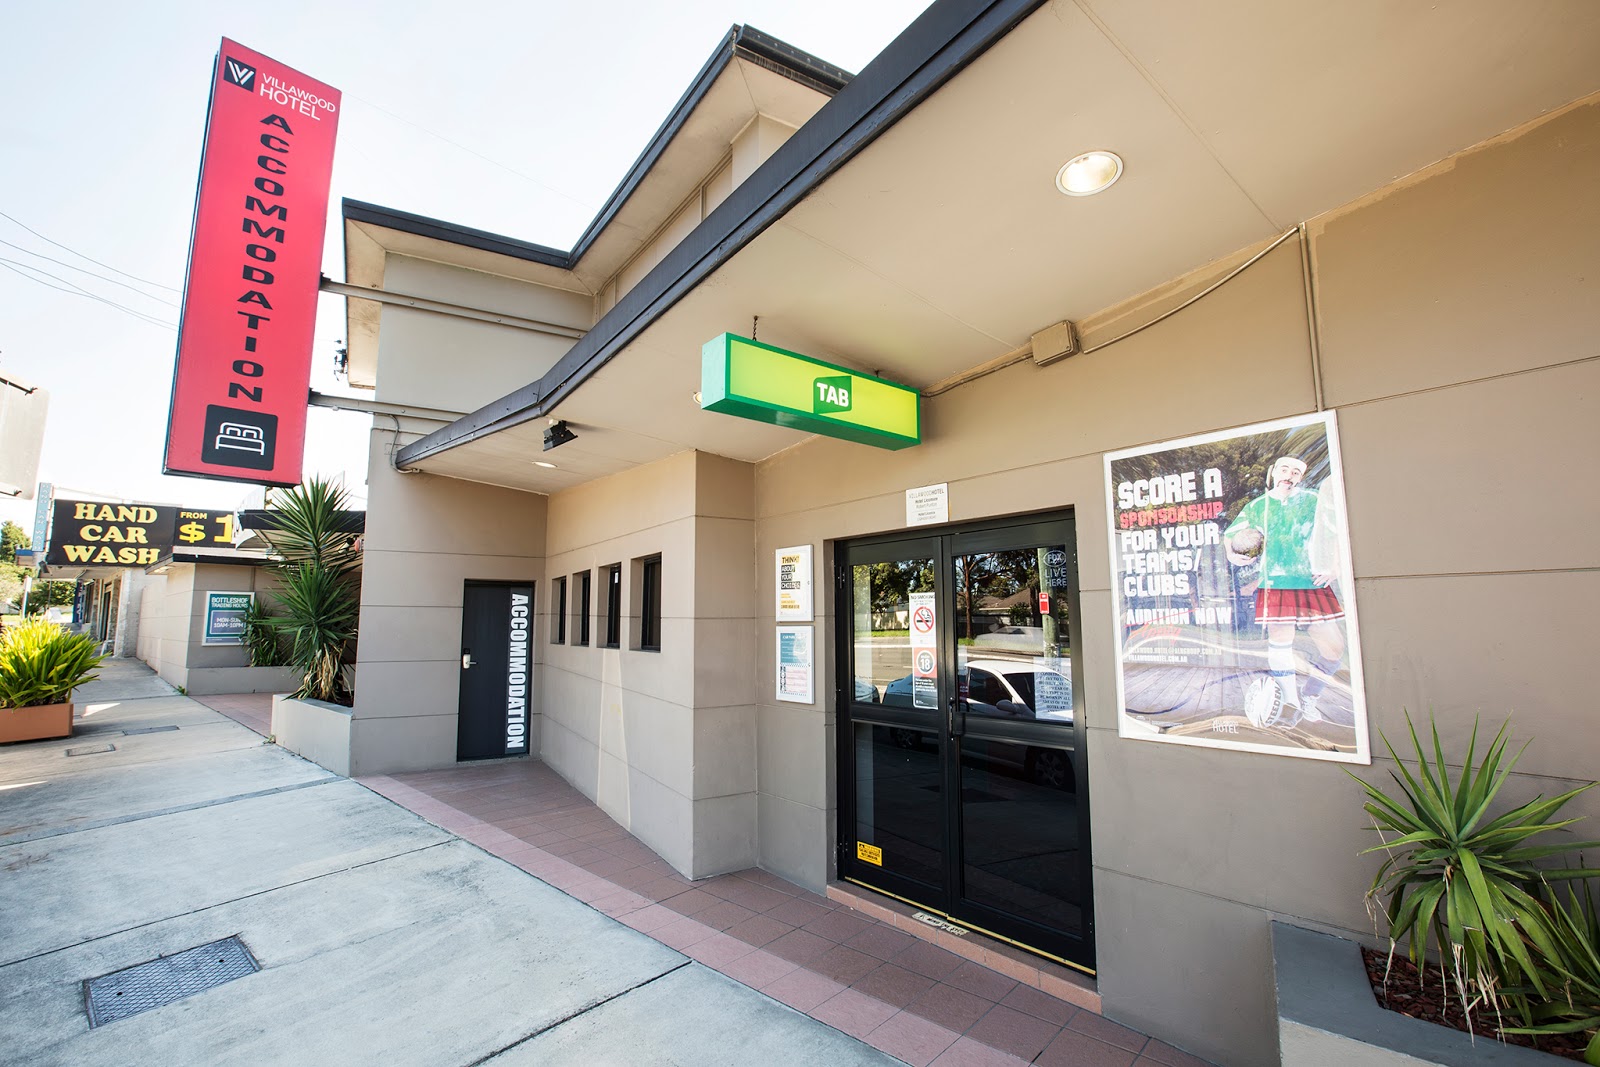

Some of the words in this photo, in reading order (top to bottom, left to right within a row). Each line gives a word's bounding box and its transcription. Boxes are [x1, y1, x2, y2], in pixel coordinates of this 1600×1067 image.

[260, 83, 321, 121] HOTEL
[262, 73, 336, 113] VILLAWOOD
[228, 113, 294, 403] ACCOMMODATION
[816, 382, 849, 407] TAB
[1117, 471, 1197, 509] SCORE
[1203, 467, 1223, 499] A
[73, 502, 158, 524] HAND
[180, 511, 208, 520] FROM
[1120, 501, 1224, 529] SPONSORSHIP
[79, 525, 148, 544] CAR
[1121, 529, 1158, 553] FOR
[1161, 522, 1220, 549] YOUR
[62, 545, 161, 565] WASH
[1122, 548, 1202, 574] TEAMS/
[1044, 567, 1067, 578] LIVE
[1044, 578, 1067, 587] HERE
[1124, 573, 1190, 597] CLUBS
[1126, 607, 1190, 625] AUDITION
[1195, 606, 1232, 625] NOW
[506, 593, 529, 749] ACCOMMODATION
[920, 658, 931, 670] 18
[1265, 686, 1281, 724] STEEDEN
[1212, 724, 1239, 734] HOTEL
